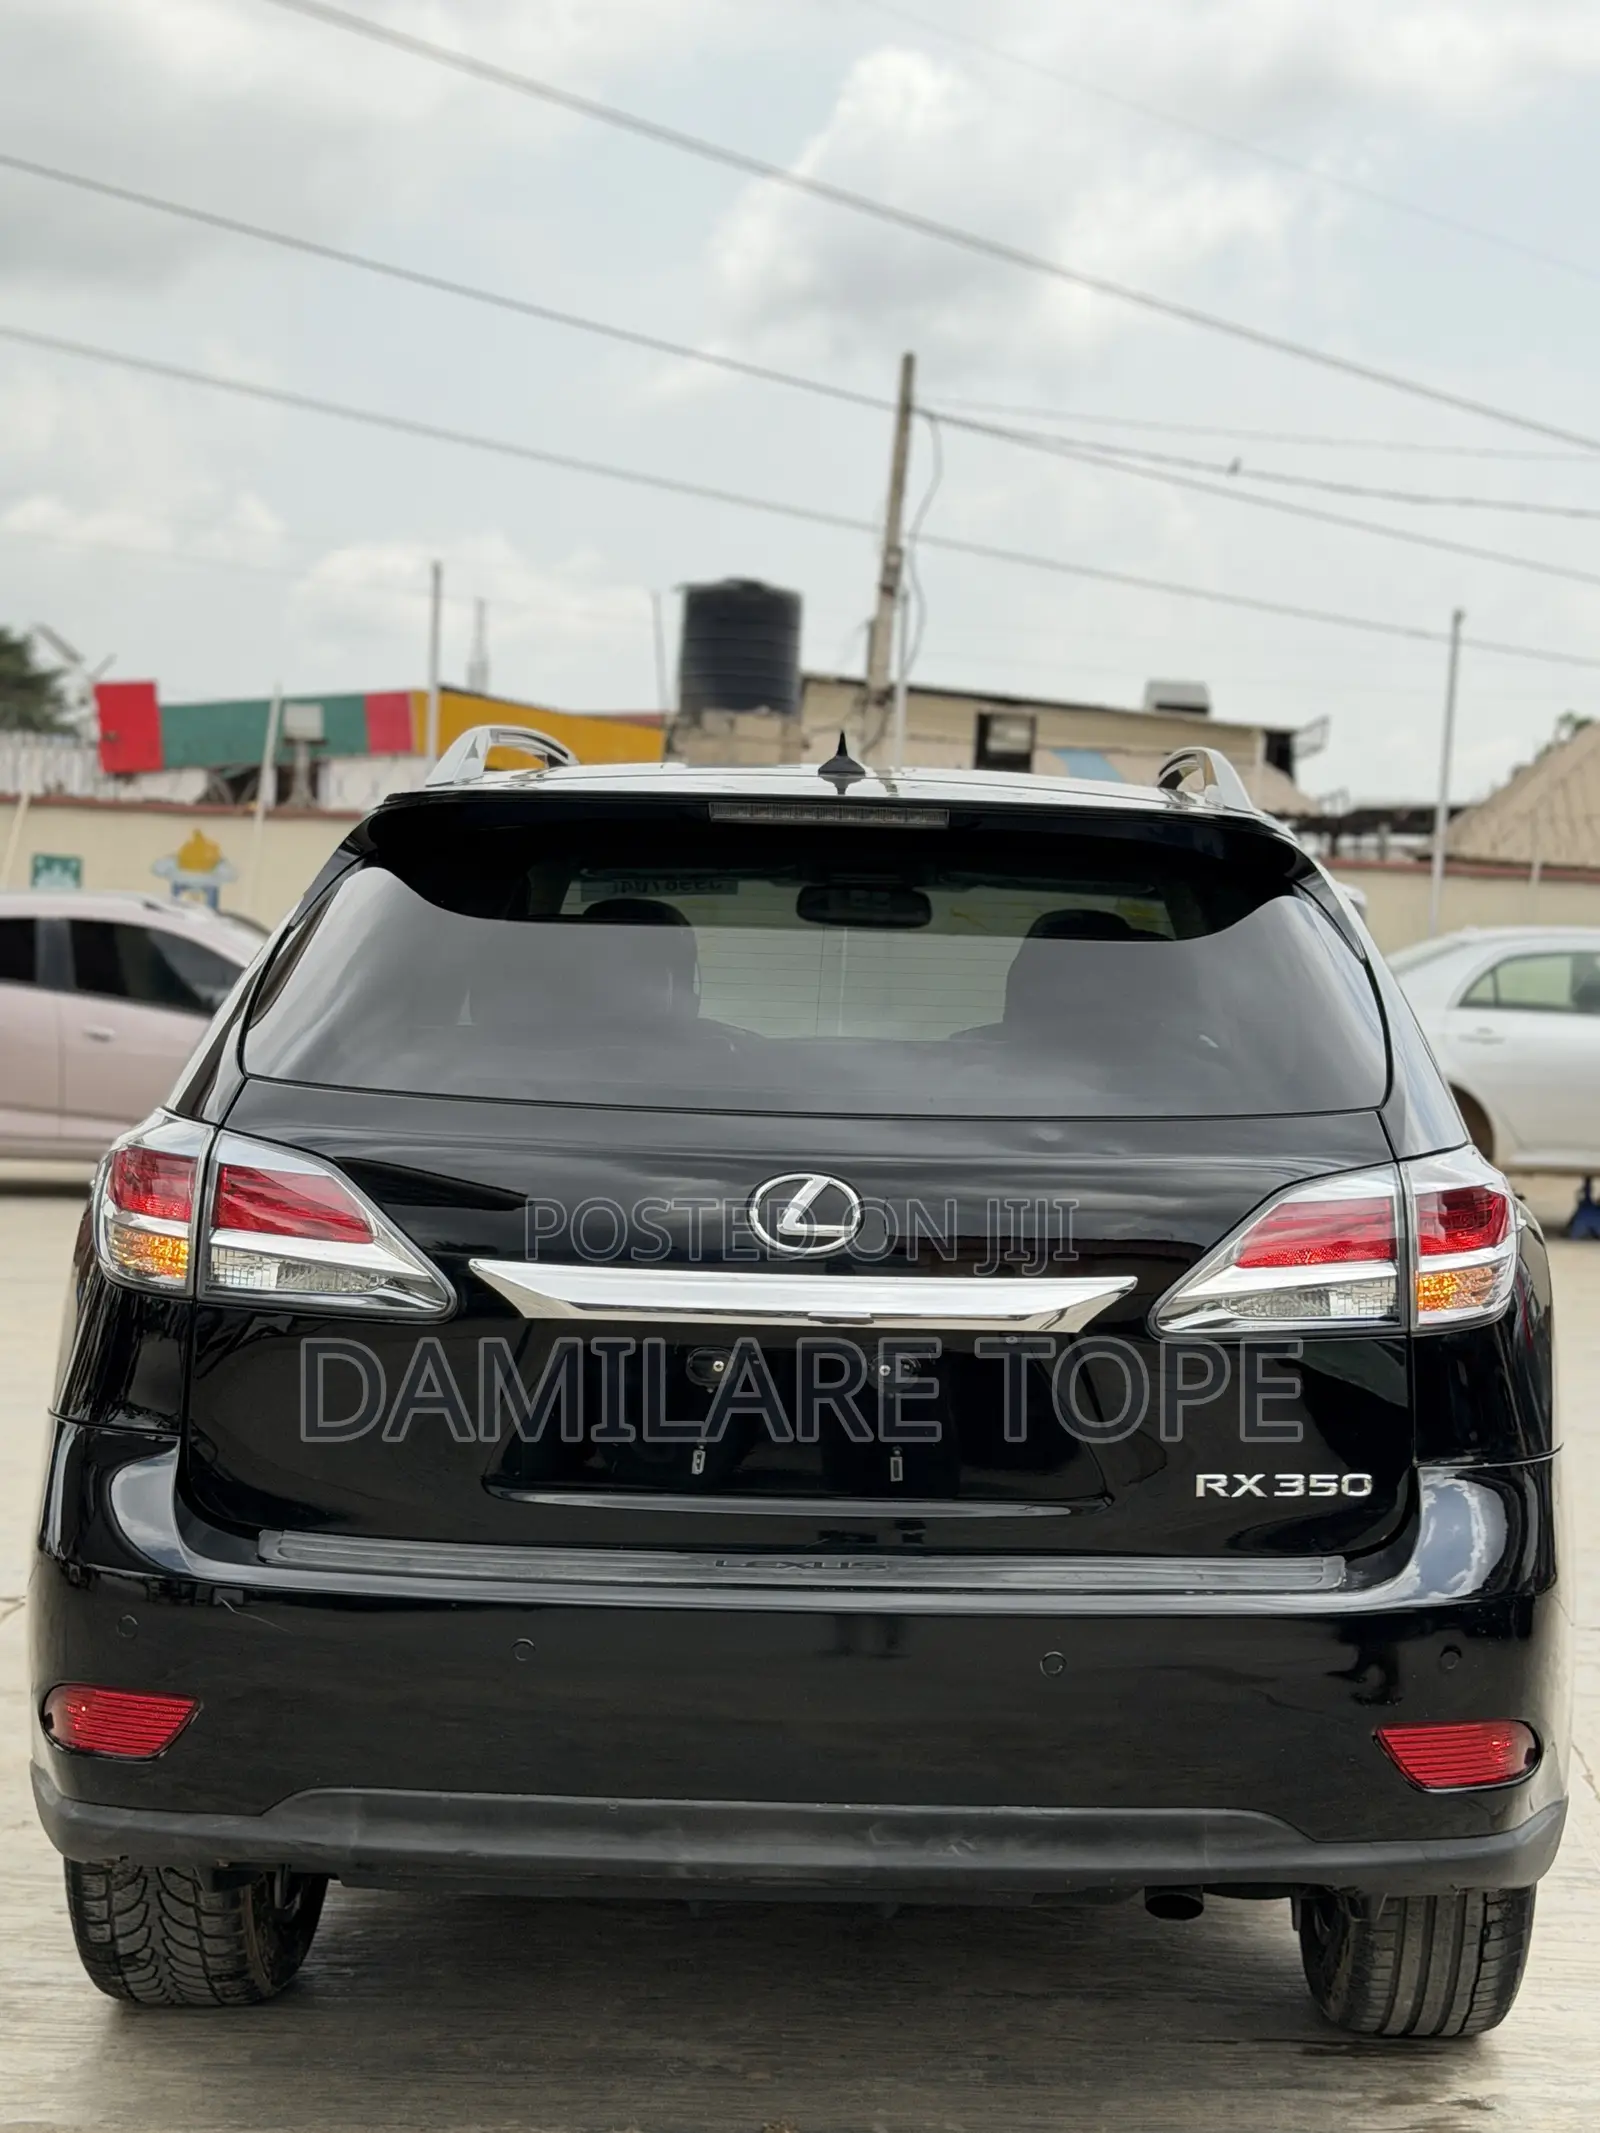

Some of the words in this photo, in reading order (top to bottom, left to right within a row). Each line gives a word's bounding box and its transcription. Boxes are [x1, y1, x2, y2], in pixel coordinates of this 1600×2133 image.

[1195, 1474, 1266, 1498] RX
[1274, 1473, 1373, 1498] 350
[715, 1559, 887, 1570] LEXUS
